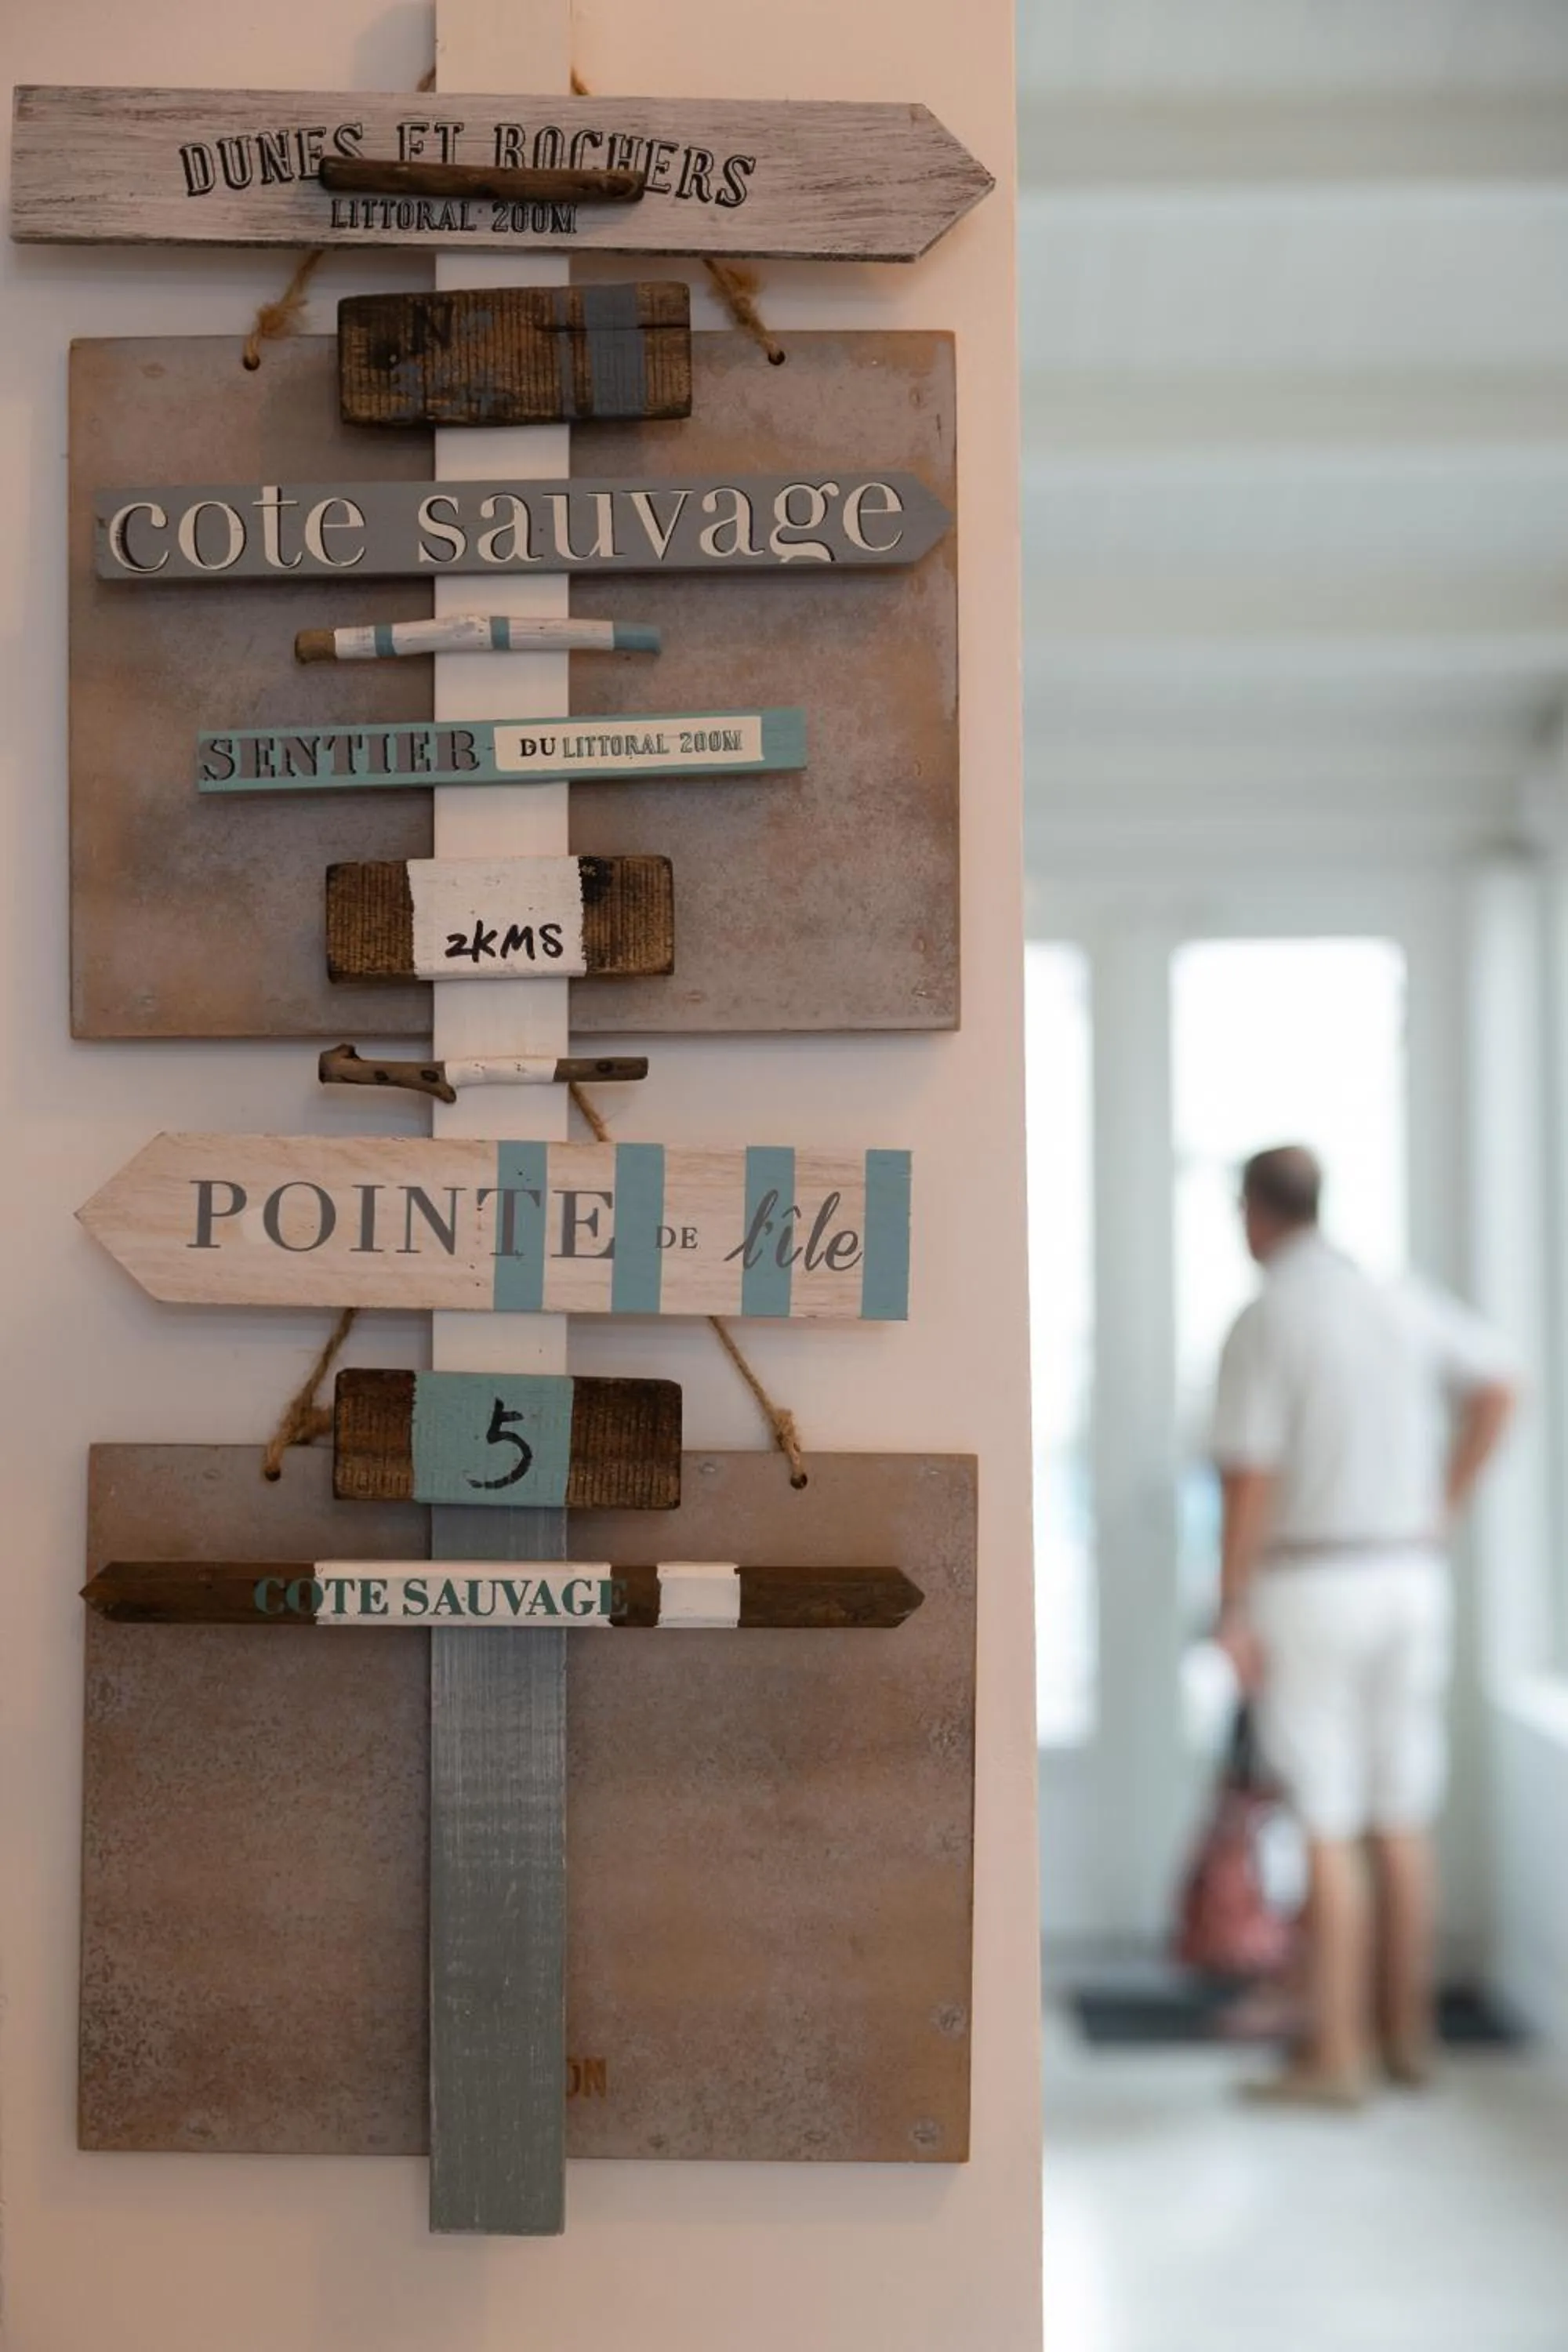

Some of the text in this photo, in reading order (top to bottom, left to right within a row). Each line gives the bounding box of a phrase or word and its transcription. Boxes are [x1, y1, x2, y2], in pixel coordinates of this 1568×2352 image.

[180, 122, 757, 207] DUNES ET ROCHERS
[331, 198, 579, 234] LITTORAL 200M
[109, 481, 906, 574] cote sauvage
[199, 729, 482, 782] SENTIER
[519, 729, 743, 759] DU LITTORAL 200M
[187, 1179, 615, 1260] POINTE
[655, 1225, 699, 1250] DE
[467, 1396, 533, 1489] 5
[254, 1577, 628, 1617] COTE SAUVAGE
